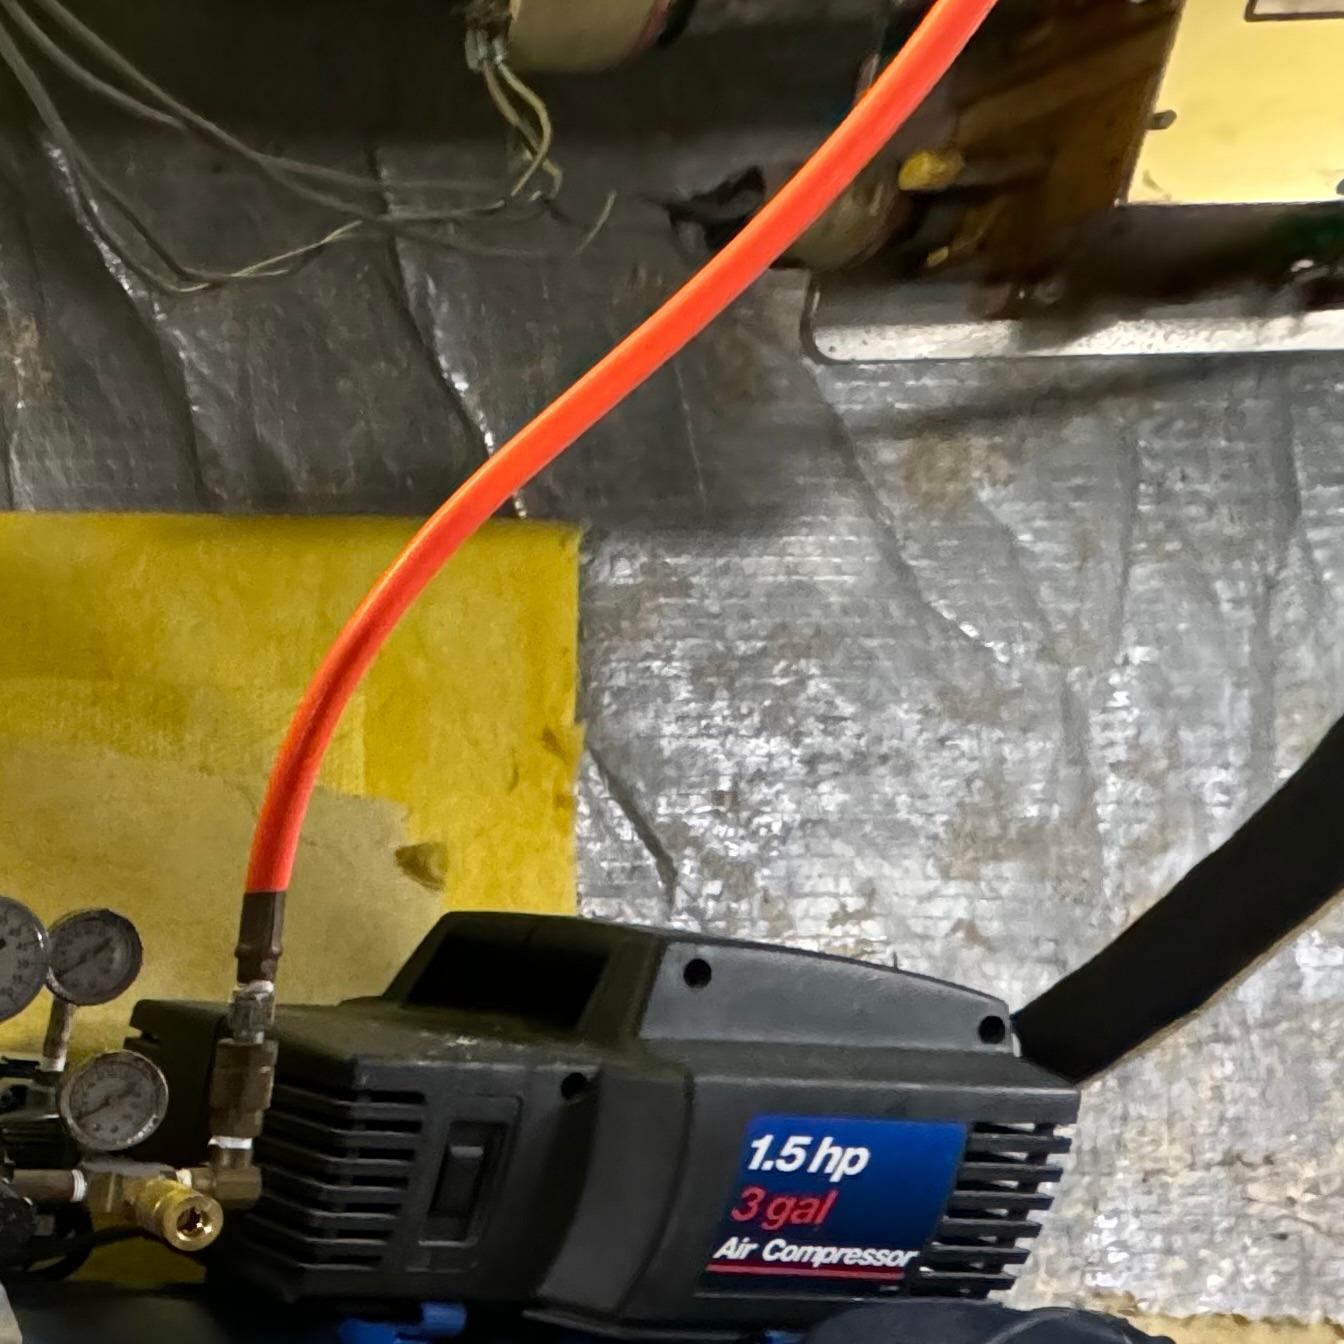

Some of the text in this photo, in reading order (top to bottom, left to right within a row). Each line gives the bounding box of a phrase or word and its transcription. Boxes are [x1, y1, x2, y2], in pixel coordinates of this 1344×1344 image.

[748, 1134, 871, 1182] 1.5 hp
[731, 1185, 839, 1231] 3 gal
[712, 1236, 919, 1268] Air Compressor
